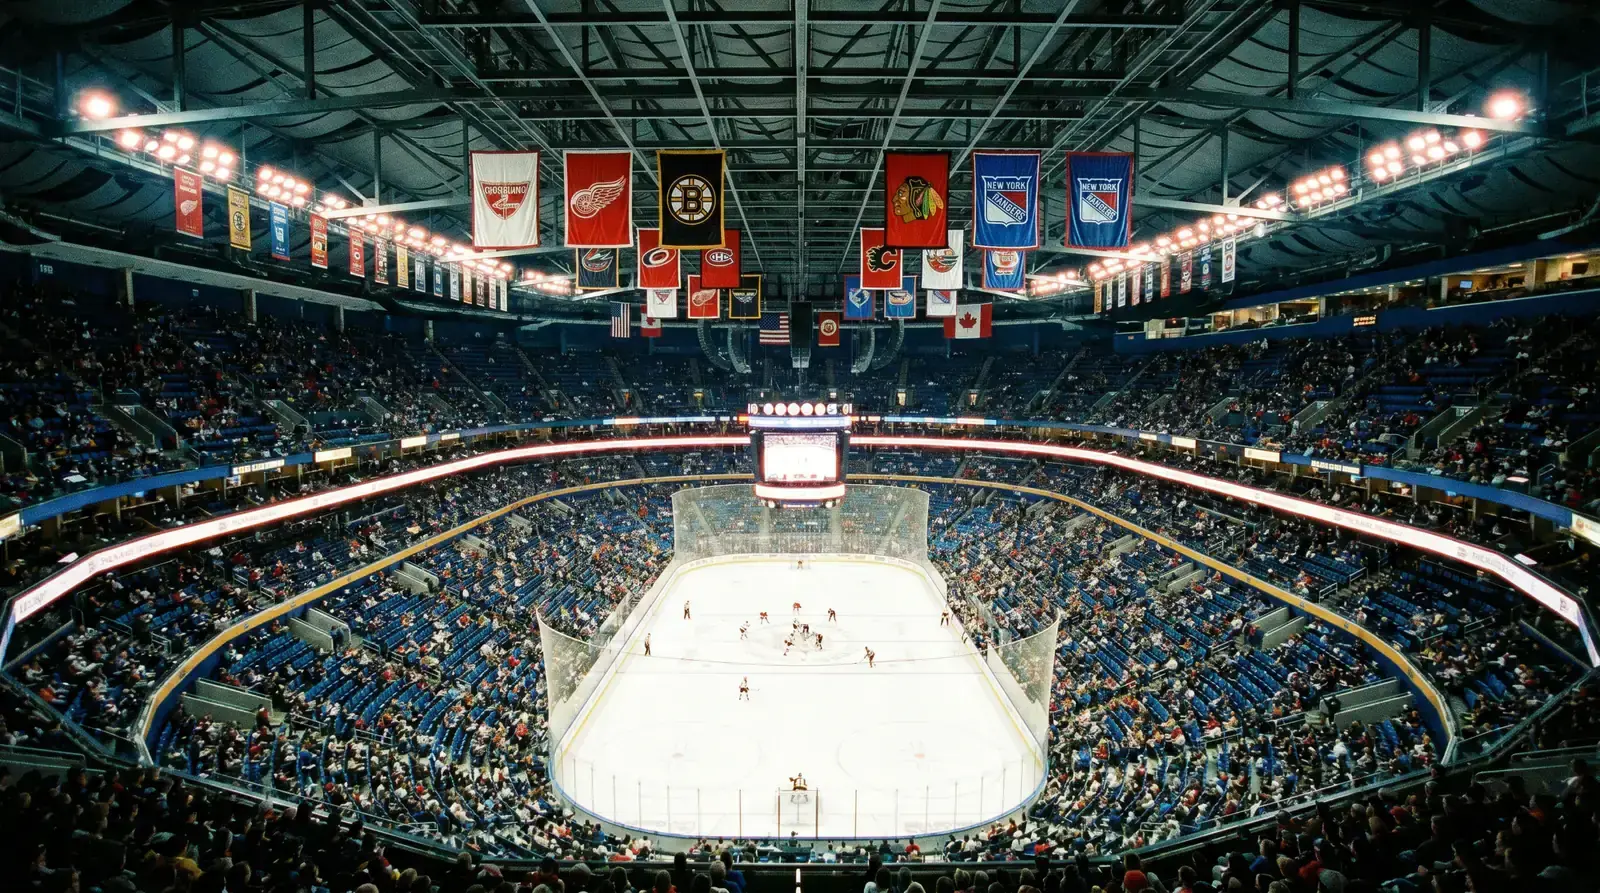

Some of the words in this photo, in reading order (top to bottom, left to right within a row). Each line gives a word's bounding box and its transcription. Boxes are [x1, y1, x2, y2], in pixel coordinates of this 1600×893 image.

[987, 181, 1004, 190] NEW
[1006, 181, 1026, 190] YORK
[1082, 183, 1098, 191] NEW
[1099, 183, 1117, 191] YORK
[680, 185, 703, 215] B
[991, 193, 1026, 220] RANGERS
